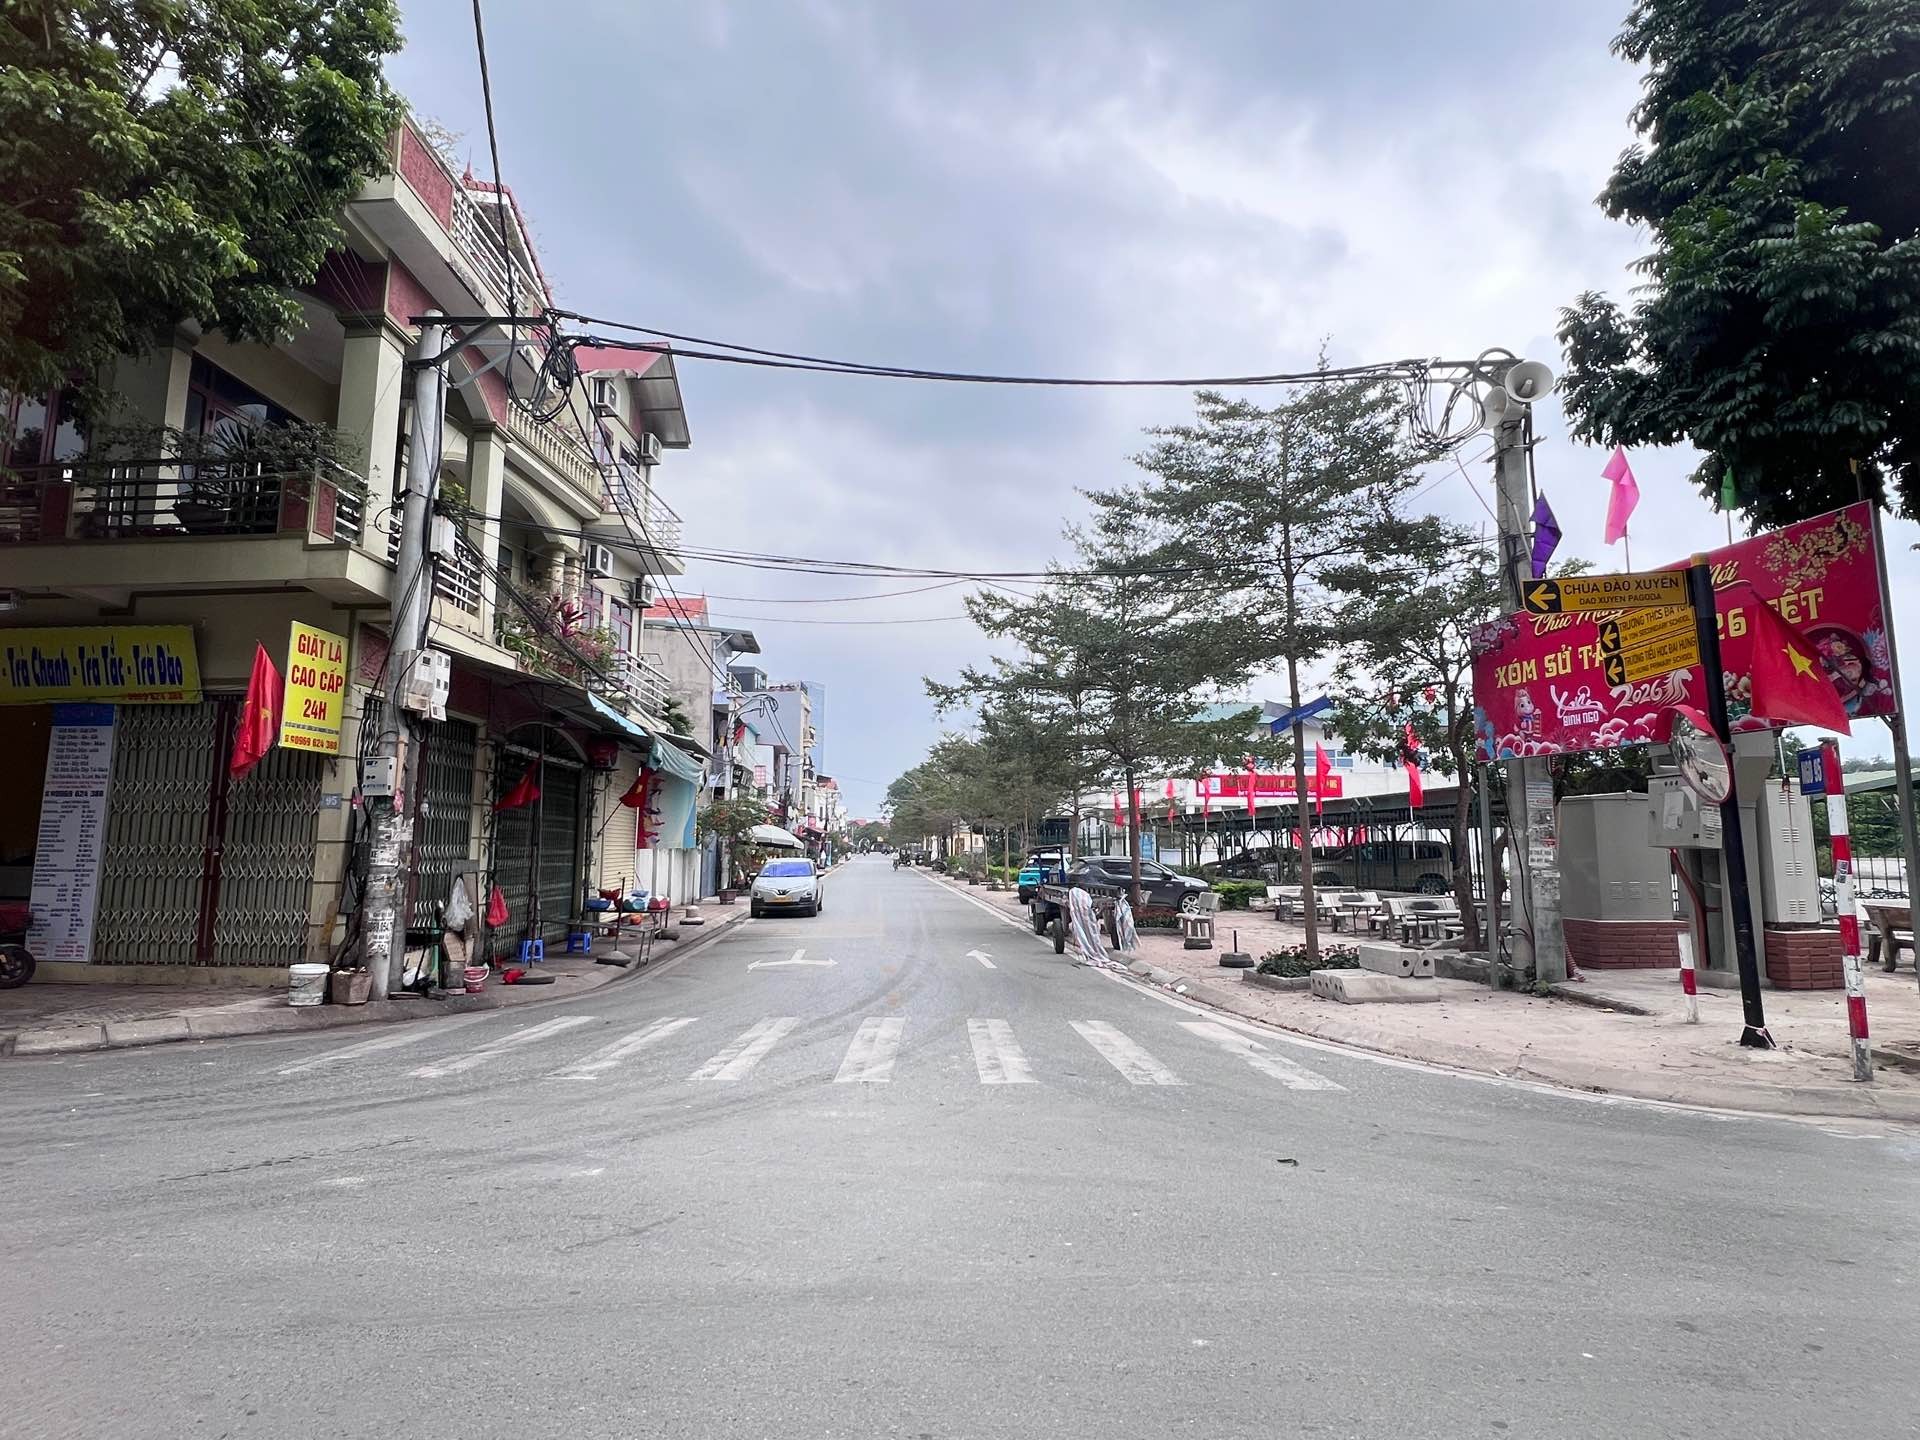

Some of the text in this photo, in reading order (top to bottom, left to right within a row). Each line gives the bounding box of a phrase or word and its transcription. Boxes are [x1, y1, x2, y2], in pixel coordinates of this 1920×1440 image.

[1579, 592, 1662, 606] DAO XUYEN PAGODA
[297, 633, 326, 662] GIẶT
[7, 643, 31, 687] Trà
[31, 646, 71, 687] Chanh
[78, 643, 101, 687] Trà
[132, 643, 156, 686] Trà
[291, 664, 344, 694] CAO CẤP
[1495, 657, 1538, 689] XÓM
[302, 698, 327, 721] 24H
[1609, 679, 1663, 714] 2026
